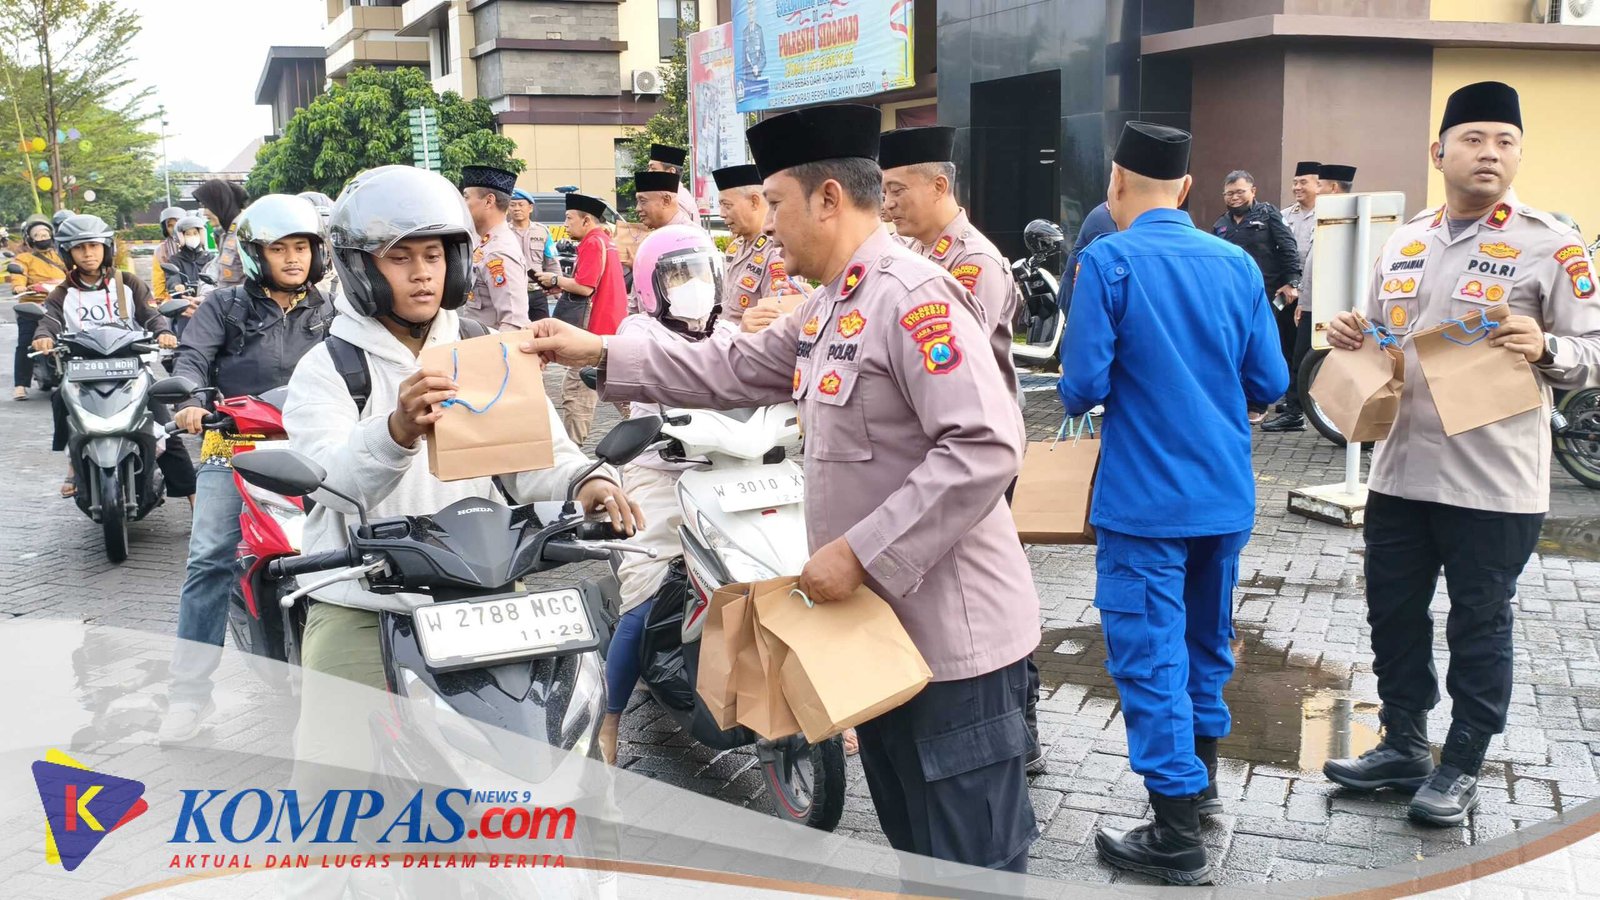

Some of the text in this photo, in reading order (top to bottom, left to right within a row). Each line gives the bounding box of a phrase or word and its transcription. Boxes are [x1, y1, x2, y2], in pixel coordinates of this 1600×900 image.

[746, 263, 762, 276] POLRI
[1468, 259, 1516, 277] POLRI
[827, 343, 858, 361] POLRI
[72, 363, 80, 371] W
[114, 361, 134, 369] NDH
[713, 474, 804, 497] W 3010 X
[457, 507, 494, 516] HONDA
[425, 595, 578, 632] W 2788 NGC
